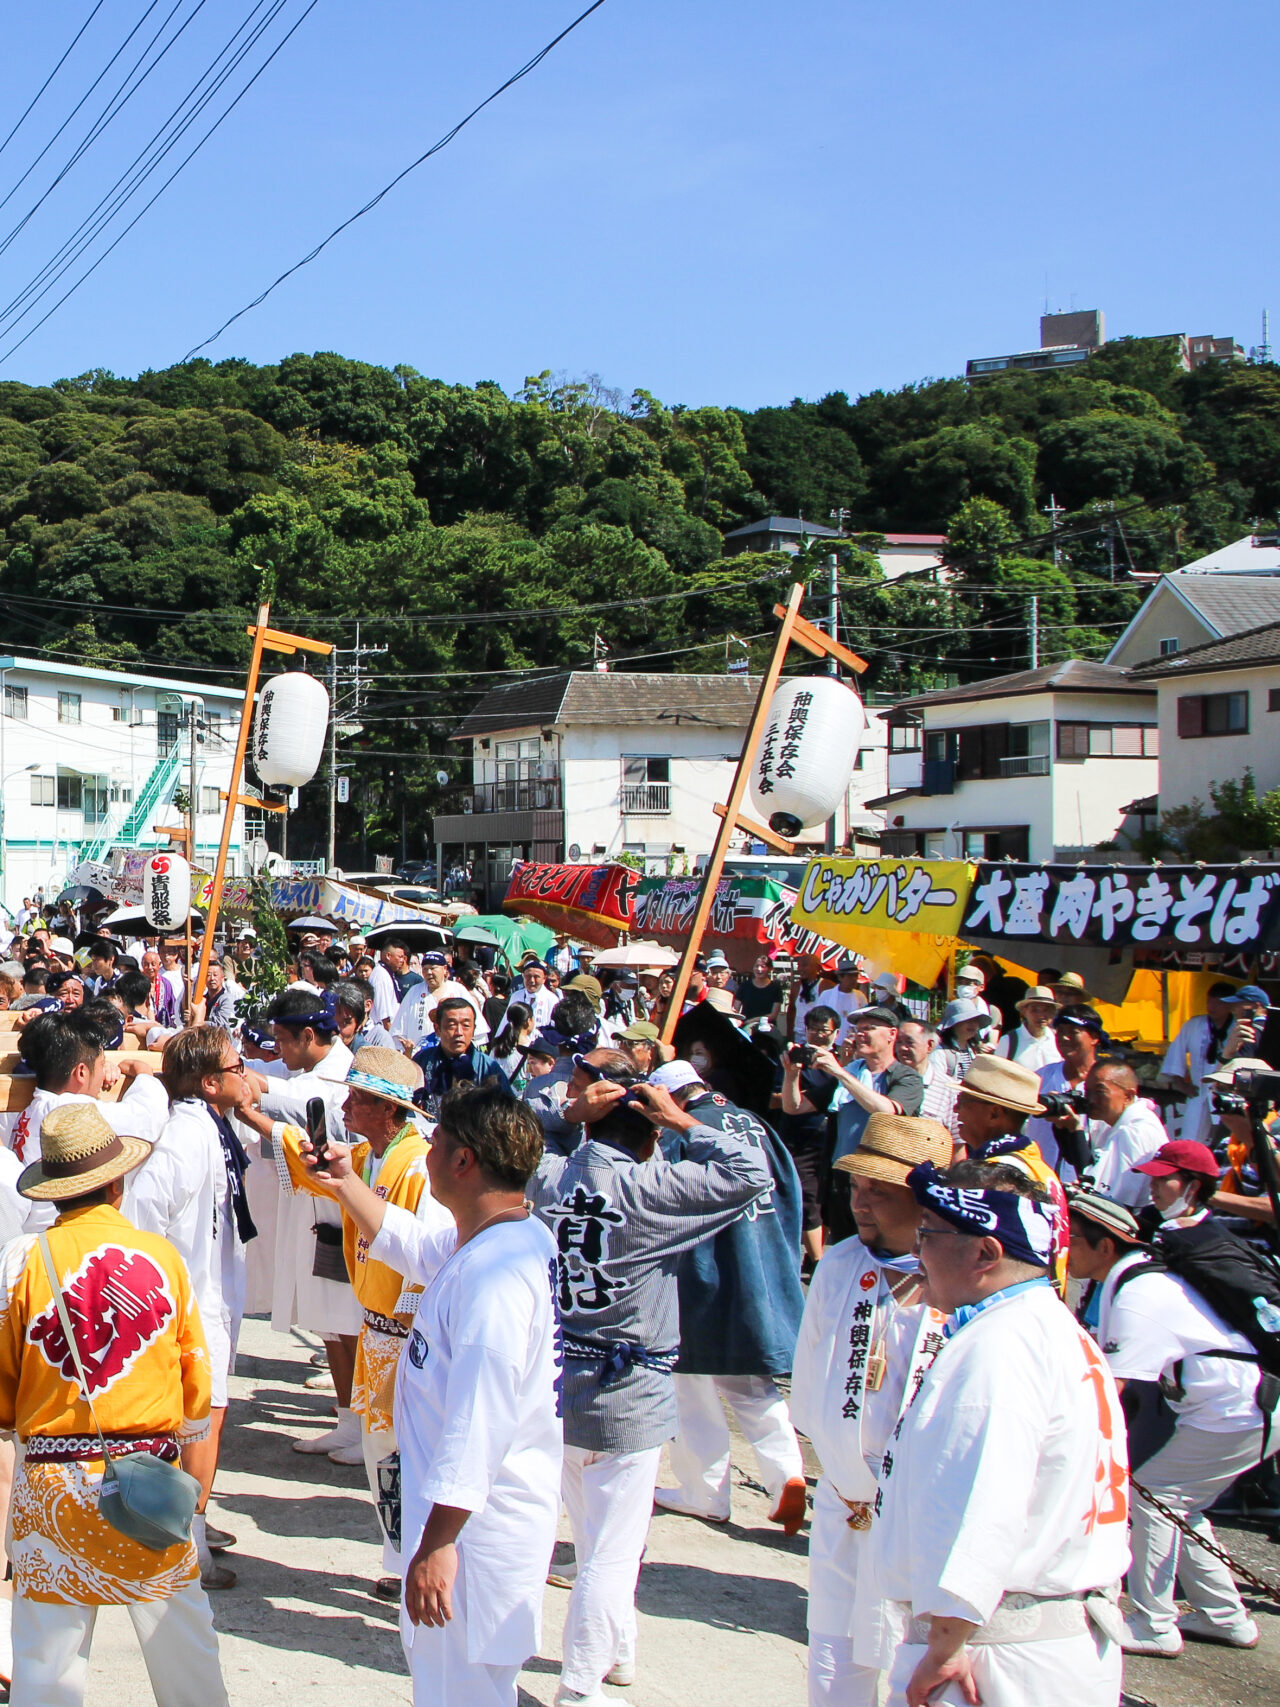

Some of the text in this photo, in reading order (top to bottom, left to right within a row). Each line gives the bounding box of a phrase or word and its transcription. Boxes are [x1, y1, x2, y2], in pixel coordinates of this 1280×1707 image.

[758, 723, 779, 795] 三十五年会
[151, 875, 172, 926] 貴船祭
[803, 863, 957, 923] じゃがバター
[842, 1300, 874, 1420] 神輿保存会
